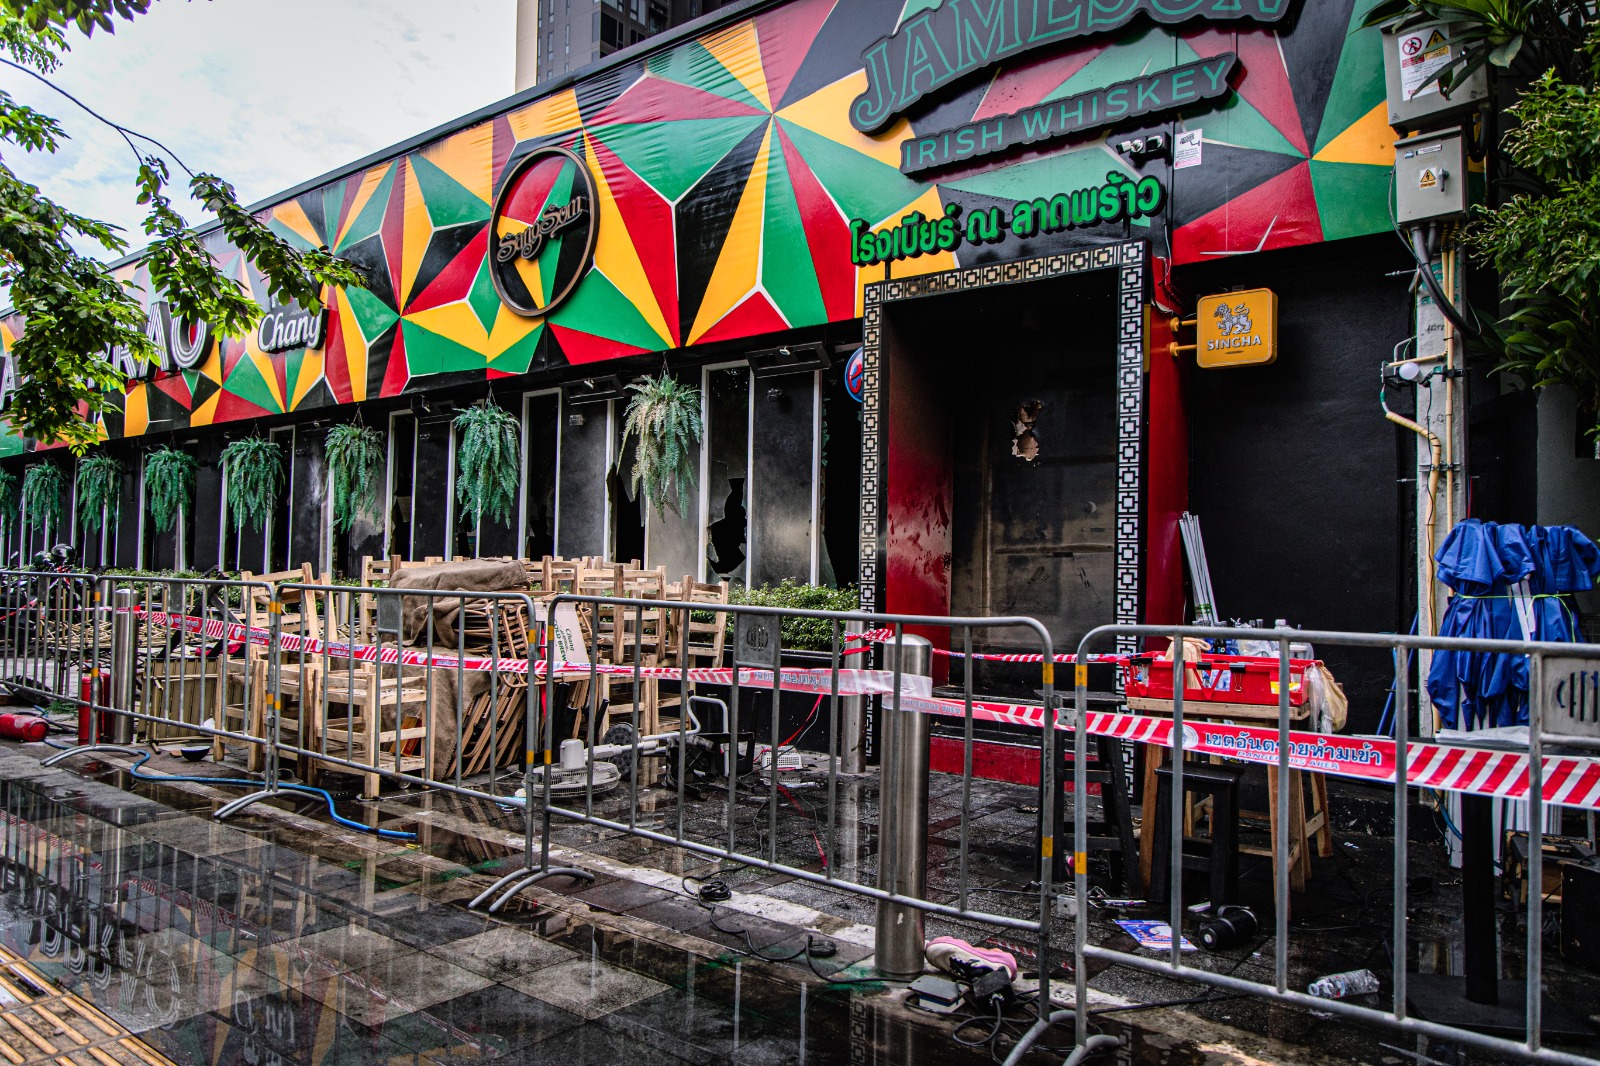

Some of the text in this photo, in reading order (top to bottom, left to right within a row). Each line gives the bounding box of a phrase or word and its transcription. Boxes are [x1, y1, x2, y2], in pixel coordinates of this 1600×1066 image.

[905, 60, 1228, 169] IRISH WHISKEY
[849, 172, 1161, 265] โรงเบียร์ ณ ลาดพร้าว
[258, 308, 323, 352] Chang
[1207, 334, 1262, 351] SINGHA
[1205, 732, 1382, 765] เขตอันตายห้ามเข้า
[1237, 751, 1340, 770] DANGEUS AREA
